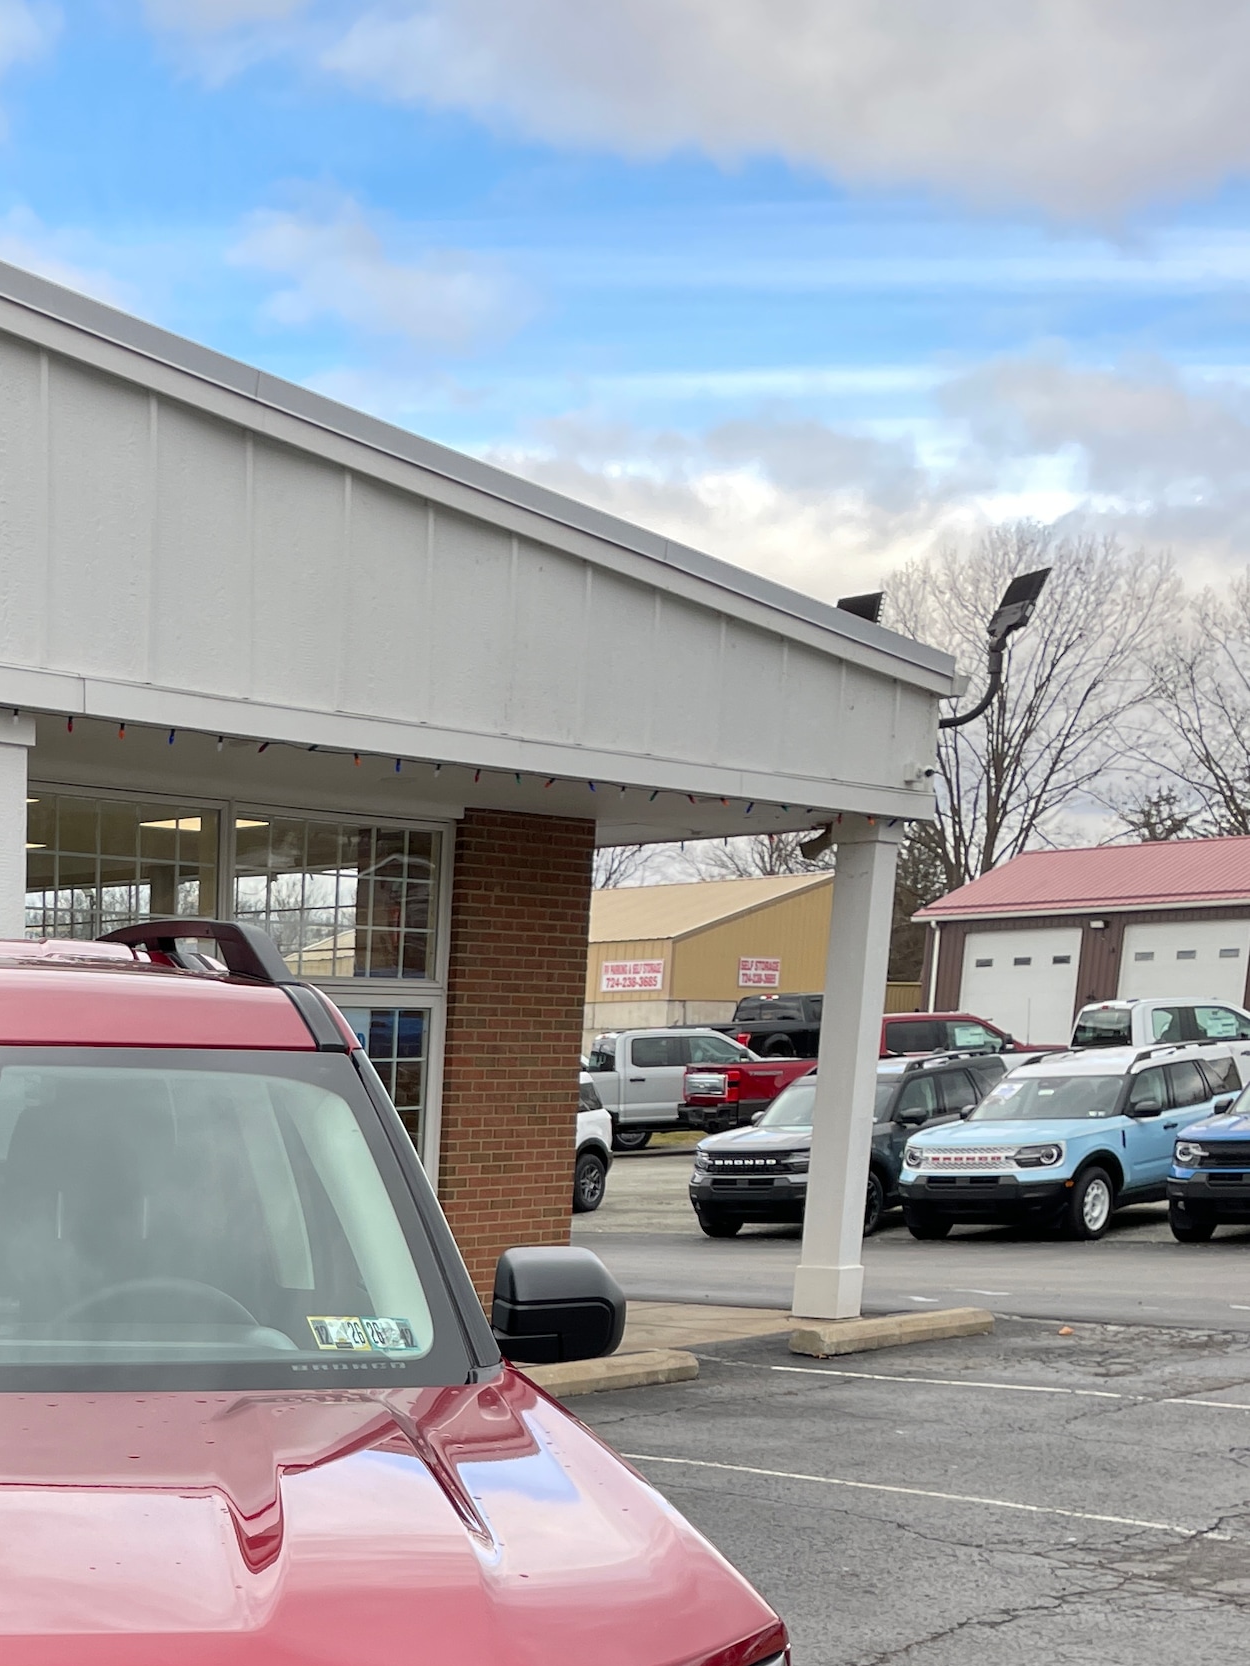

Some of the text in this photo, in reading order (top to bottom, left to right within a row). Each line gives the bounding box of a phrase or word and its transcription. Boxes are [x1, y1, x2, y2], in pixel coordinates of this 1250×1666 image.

[741, 960, 780, 971] SELF STORAGE
[315, 1322, 366, 1345] 12 26
[366, 1322, 385, 1344] 26
